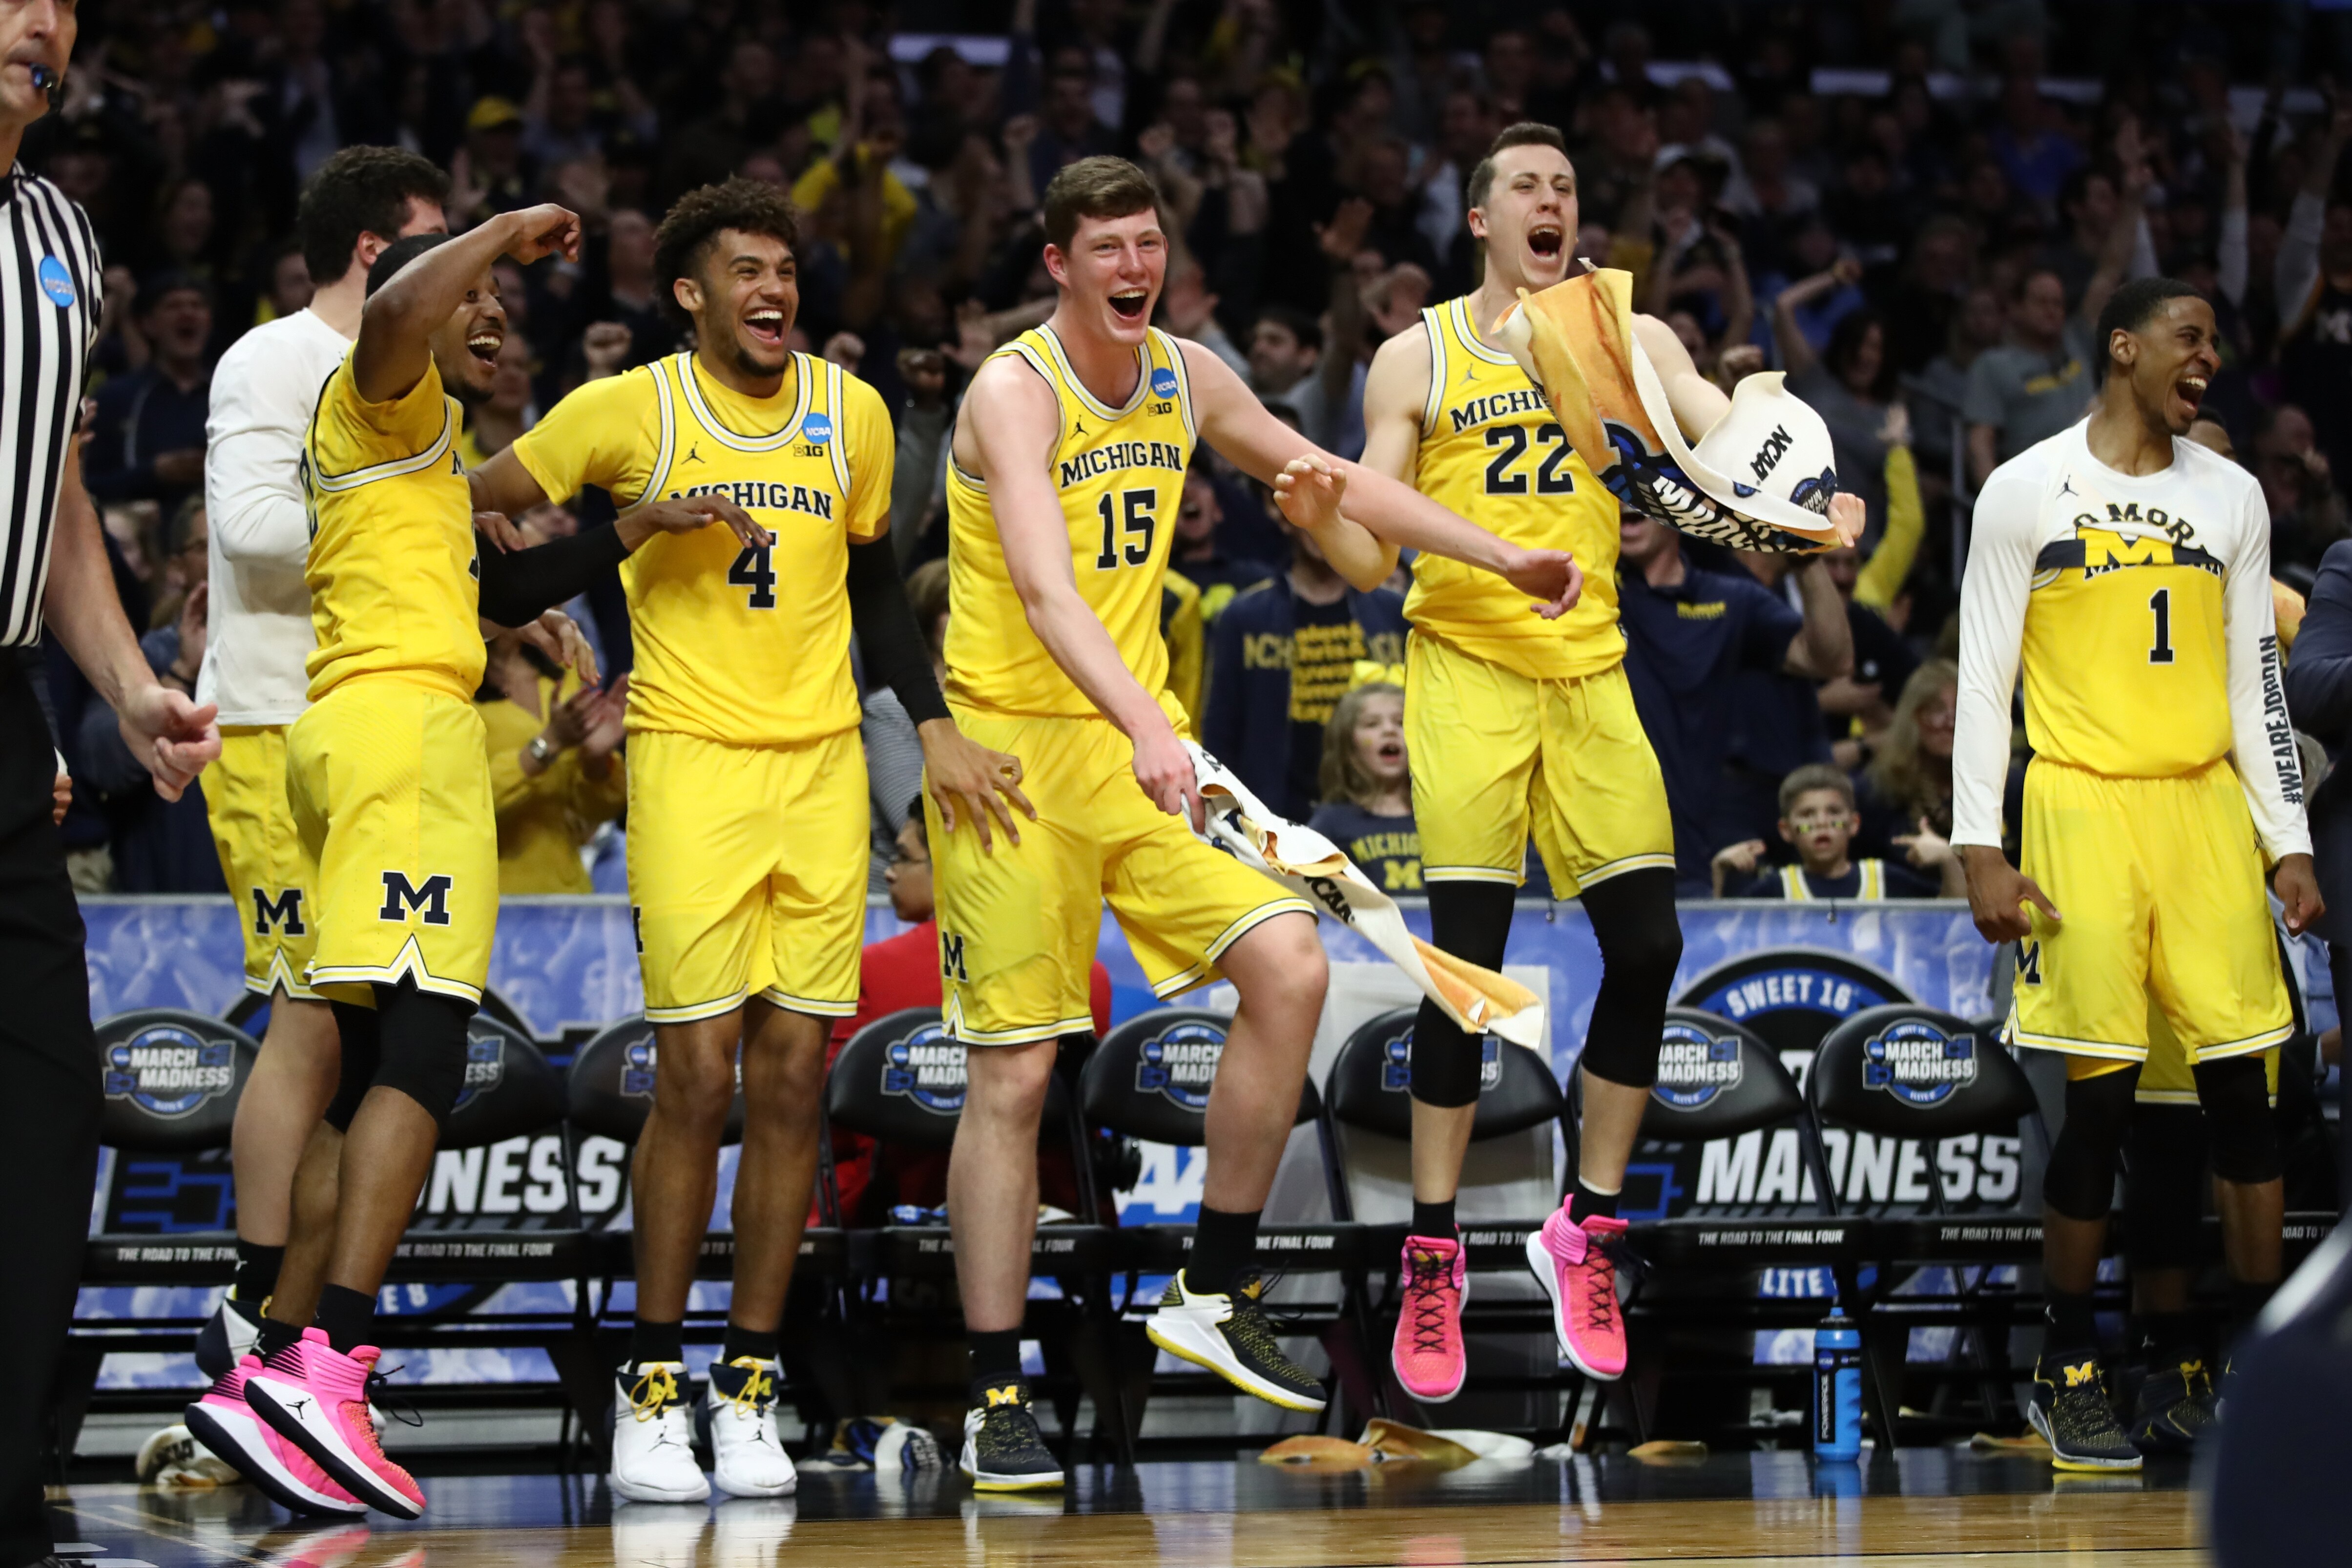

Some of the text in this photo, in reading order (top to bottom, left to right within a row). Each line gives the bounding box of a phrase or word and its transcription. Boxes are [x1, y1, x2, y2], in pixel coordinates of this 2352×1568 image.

[1155, 380, 1177, 392] NCAA
[1450, 389, 1544, 434] MICHI
[806, 426, 831, 436] NCAA
[1061, 442, 1182, 488] MICHIGAN
[1485, 423, 1575, 496] 22
[1750, 423, 1793, 481] NCAA
[1097, 489, 1156, 570] 15
[2106, 503, 2208, 553] MOR
[728, 531, 778, 609] 4
[2149, 588, 2175, 663] 1
[2259, 635, 2303, 806] #WEAREJORDAN
[1351, 832, 1421, 863] MICHIG
[1383, 860, 1422, 890] M
[252, 887, 307, 937] M
[379, 870, 453, 927] M
[942, 932, 968, 983] M
[2015, 940, 2041, 984] M
[1727, 974, 1852, 1018] SWEET 16
[130, 1048, 197, 1068] MARCH
[1885, 1042, 1943, 1061] MARCH
[138, 1067, 230, 1087] MADNESS
[917, 1066, 968, 1085] MADN
[1658, 1061, 1738, 1082] MADNESS
[1895, 1058, 1974, 1080] MADNESS
[416, 1136, 626, 1214] NESS
[1696, 1129, 2020, 1204] MADNESS
[919, 1239, 938, 1252] THE
[1044, 1238, 1075, 1252] FOUR
[1182, 1236, 1194, 1250] TH
[1255, 1235, 1335, 1250] HE FINAL FOUR
[1468, 1231, 1498, 1245] ROAD
[1499, 1231, 1514, 1245] TO
[1515, 1231, 1530, 1245] TH
[1699, 1229, 1845, 1246] THE ROAD TO THE FINAL FOUR
[1941, 1226, 2044, 1241] THE ROAD TO THE FIN
[2306, 1226, 2318, 1239] TO
[118, 1247, 238, 1261] THE ROAD TO THE FIN
[396, 1242, 554, 1257] HE ROAD TO THE FINAL FOUR
[1760, 1268, 1824, 1296] LITE
[2063, 1360, 2093, 1387] M
[986, 1385, 1018, 1408] M
